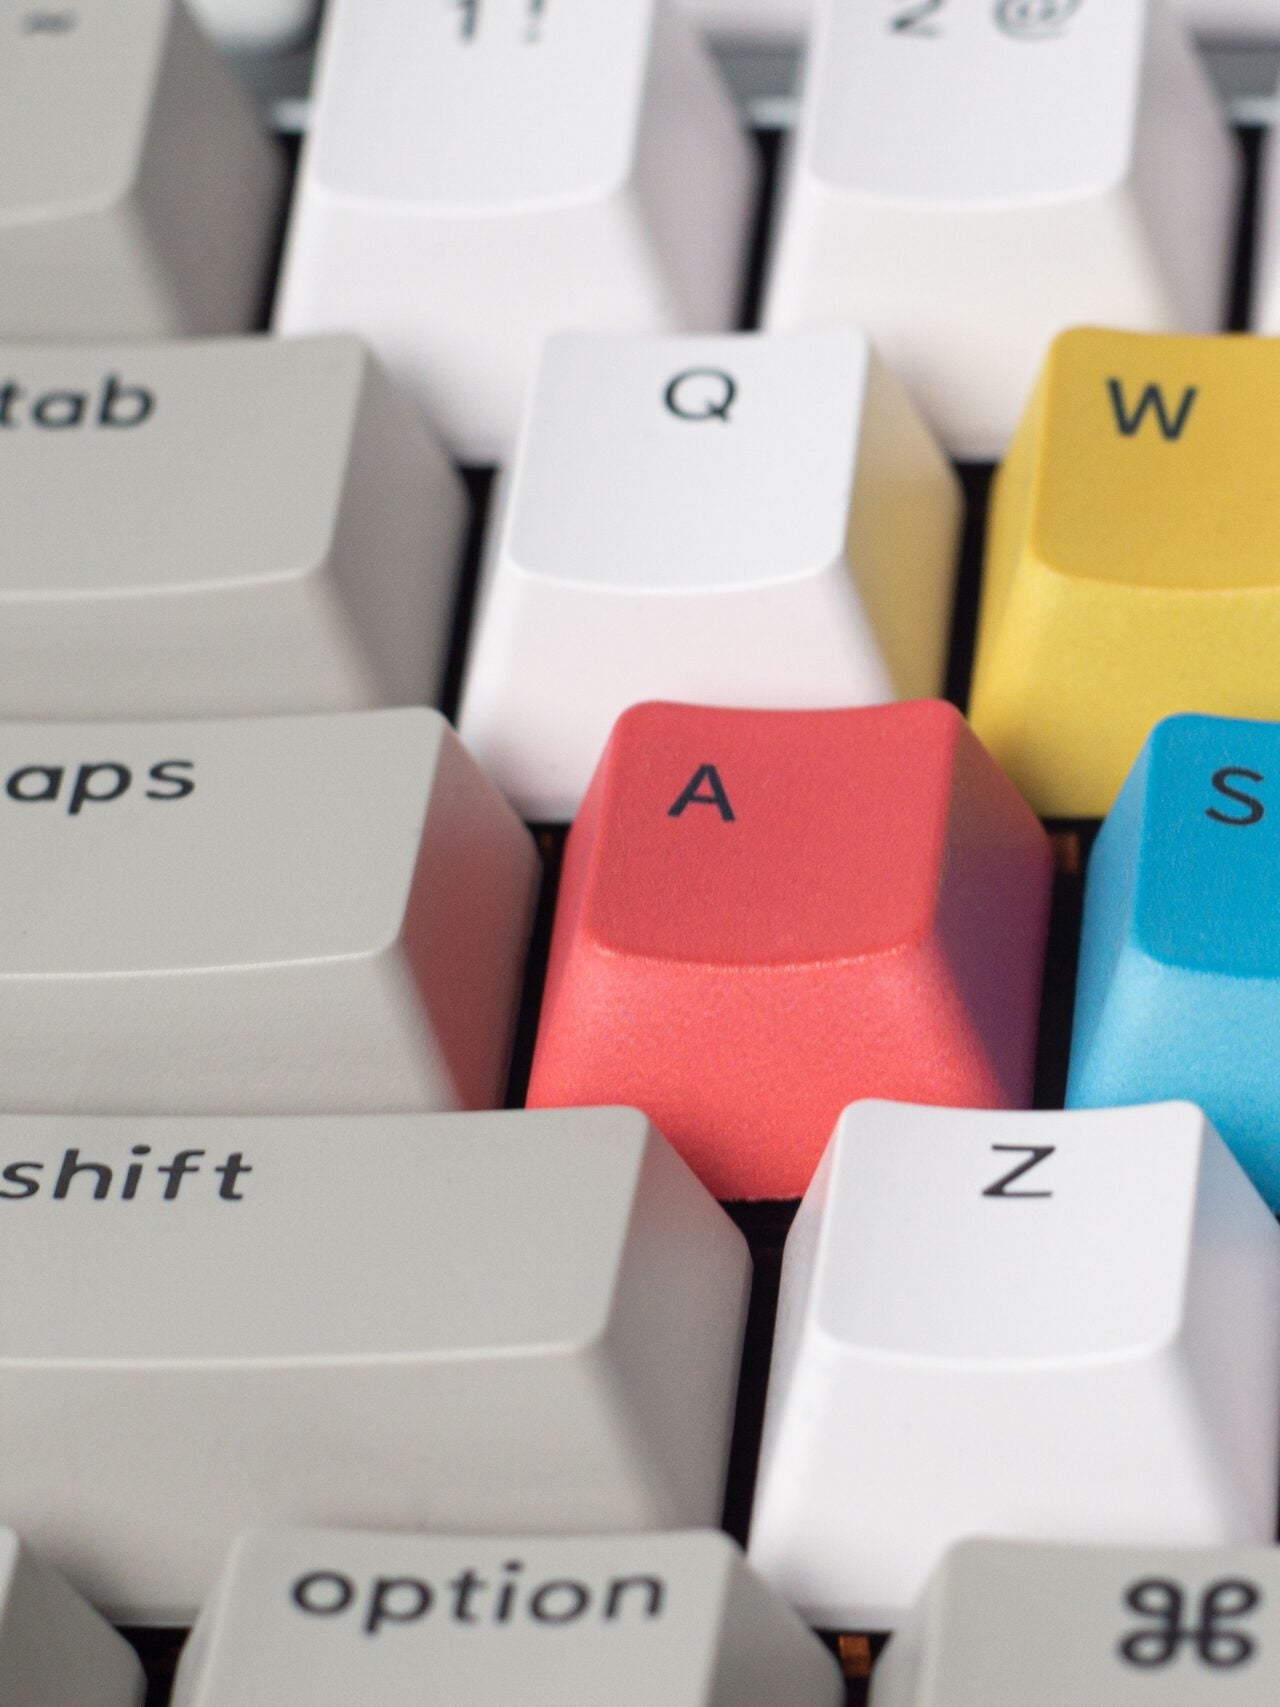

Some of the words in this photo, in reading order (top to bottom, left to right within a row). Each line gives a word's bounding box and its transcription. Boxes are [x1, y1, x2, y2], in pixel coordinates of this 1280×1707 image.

[0, 376, 156, 428] tab
[662, 367, 738, 423] Q
[1106, 377, 1198, 442] W
[667, 763, 737, 823] A
[1204, 766, 1266, 827] S
[0, 1144, 253, 1202] shift
[981, 1144, 1057, 1199] Z
[289, 1561, 665, 1637] option
